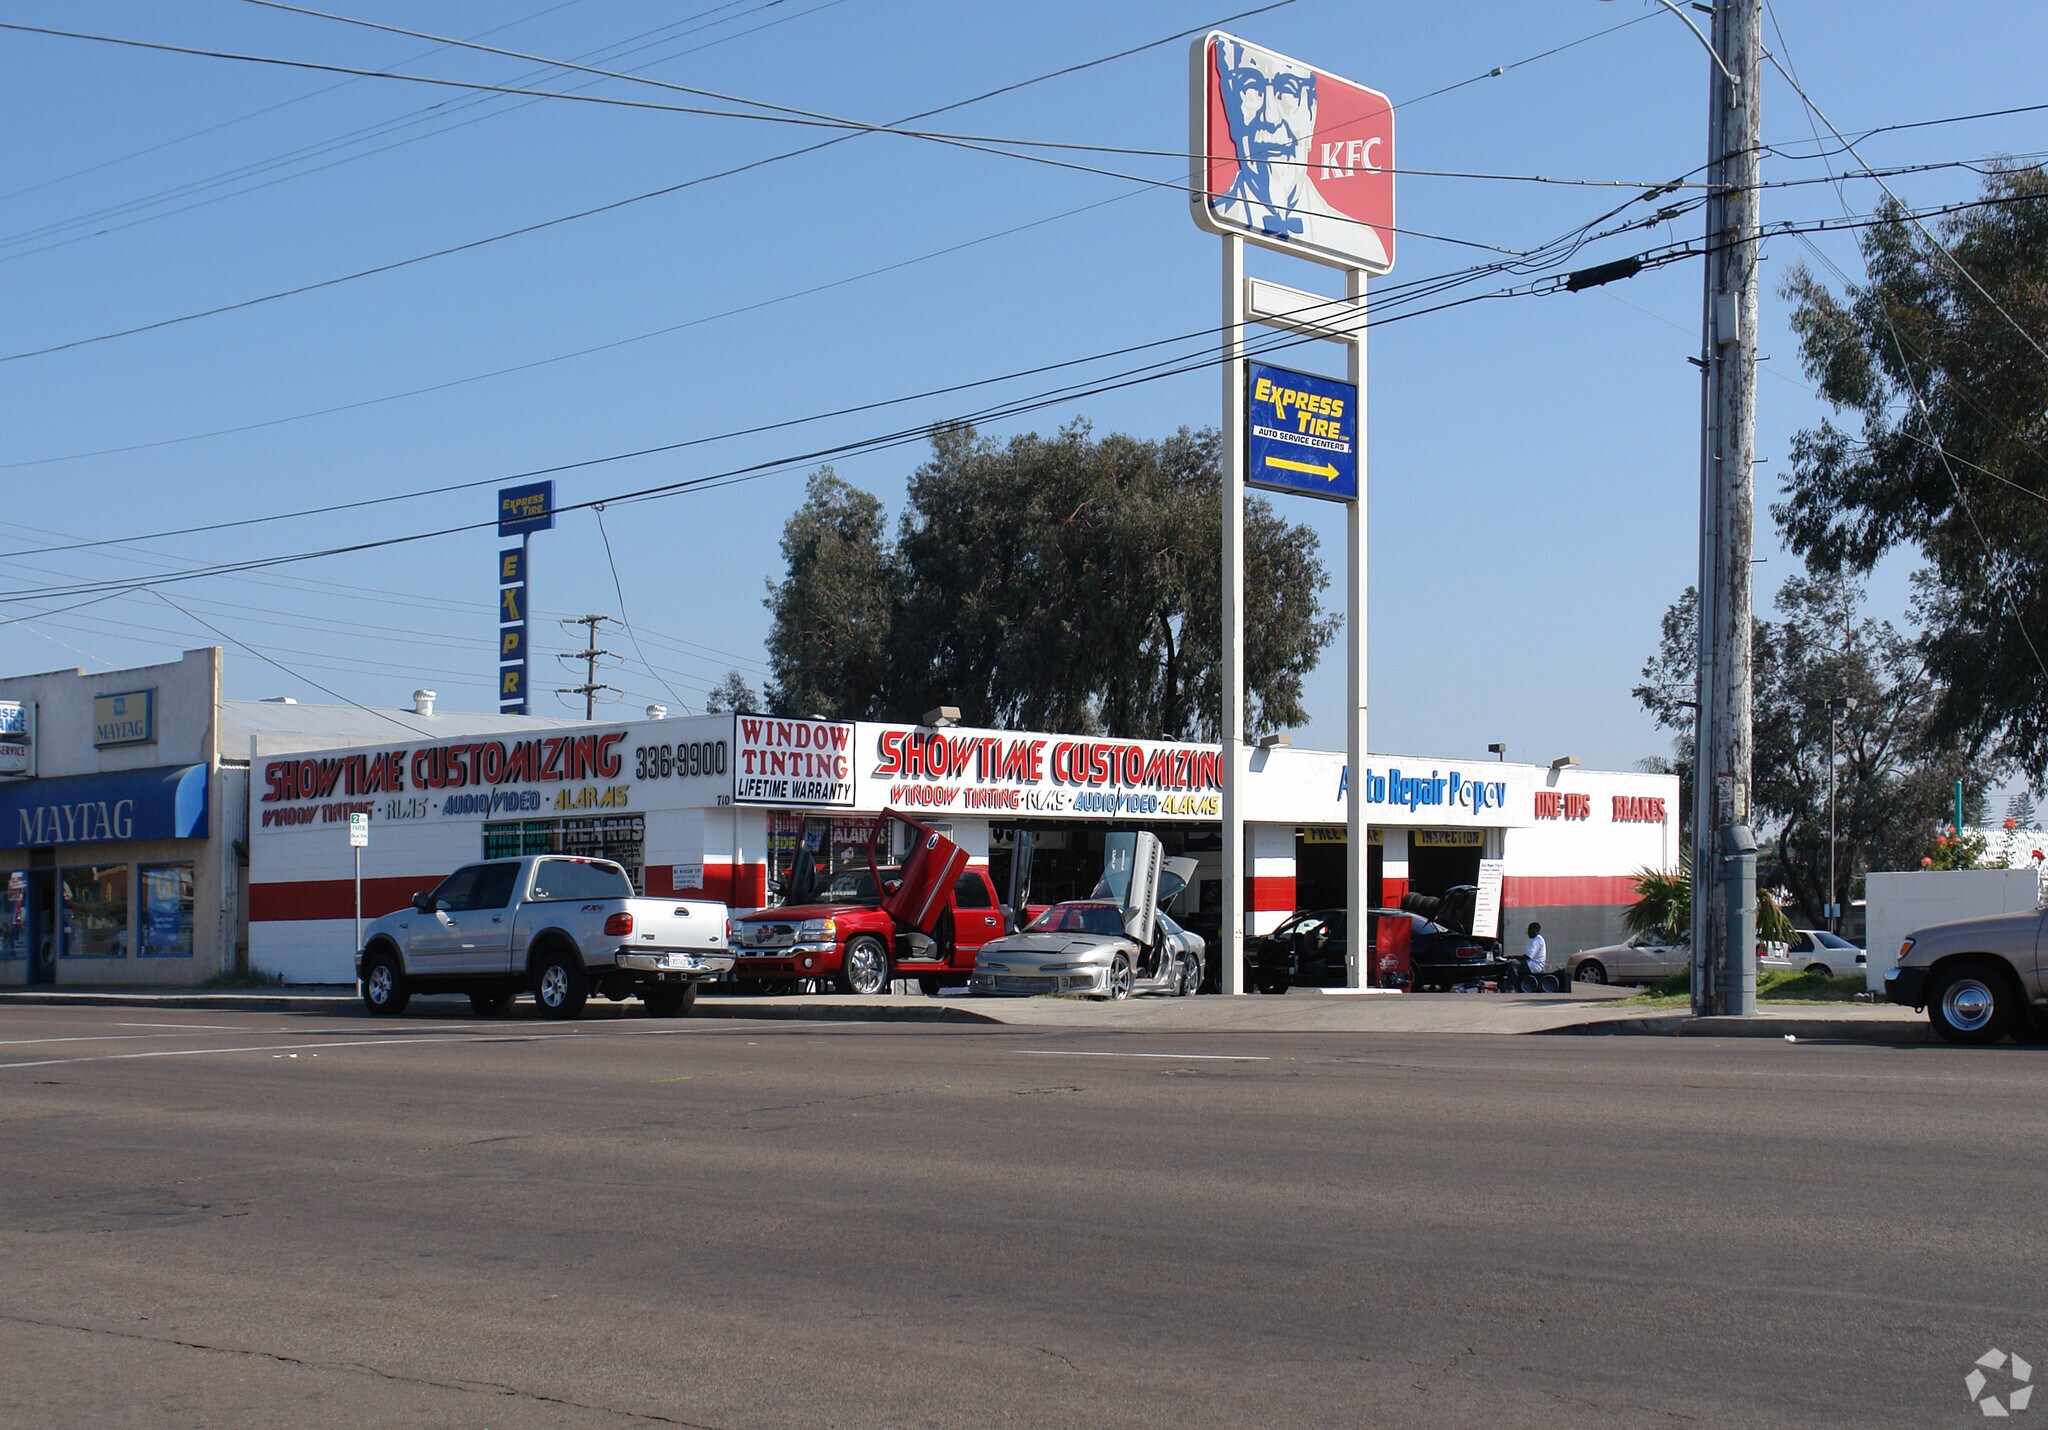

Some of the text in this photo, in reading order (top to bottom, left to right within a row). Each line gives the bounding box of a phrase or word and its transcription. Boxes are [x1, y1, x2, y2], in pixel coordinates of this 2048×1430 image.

[1320, 136, 1382, 180] KFC
[1254, 377, 1344, 420] EXPRESS
[1258, 427, 1345, 451] AUTO SERVICE CENTERS
[1297, 410, 1341, 439] TIRE
[502, 493, 545, 514] EXPRESS
[522, 505, 543, 516] TIRE
[501, 554, 521, 714] EXPR
[0, 708, 25, 719] SEN
[97, 719, 143, 740] MAYTAG
[741, 718, 850, 751] WINDOW
[261, 731, 728, 803] SHOWTIME CUSTOMIZING 336-9900
[742, 749, 848, 780] TINTING
[870, 730, 1048, 785] SHOWTIME
[717, 795, 730, 806] 710
[738, 778, 851, 800] LIFETIME WARRANTY
[890, 784, 960, 807] WINDOW
[964, 786, 1022, 811] TINTING
[1073, 787, 1158, 818] AUDIO/VIDEO
[1161, 795, 1220, 816] ALARMS
[1337, 765, 1507, 815] Ato Repair Popov
[262, 805, 319, 828] WINDOW
[321, 800, 376, 823] TINTING
[442, 787, 541, 819] AUDIO/VIDEO
[554, 785, 631, 810] ALARMS
[1535, 791, 1591, 821] UNE-UPS
[1612, 795, 1666, 824] BRAKES
[16, 799, 133, 846] MAYTAG
[567, 817, 645, 842] ALARMS
[1310, 827, 1341, 841] FREE
[767, 836, 797, 850] VIDE
[1421, 830, 1481, 845] INSPECTION
